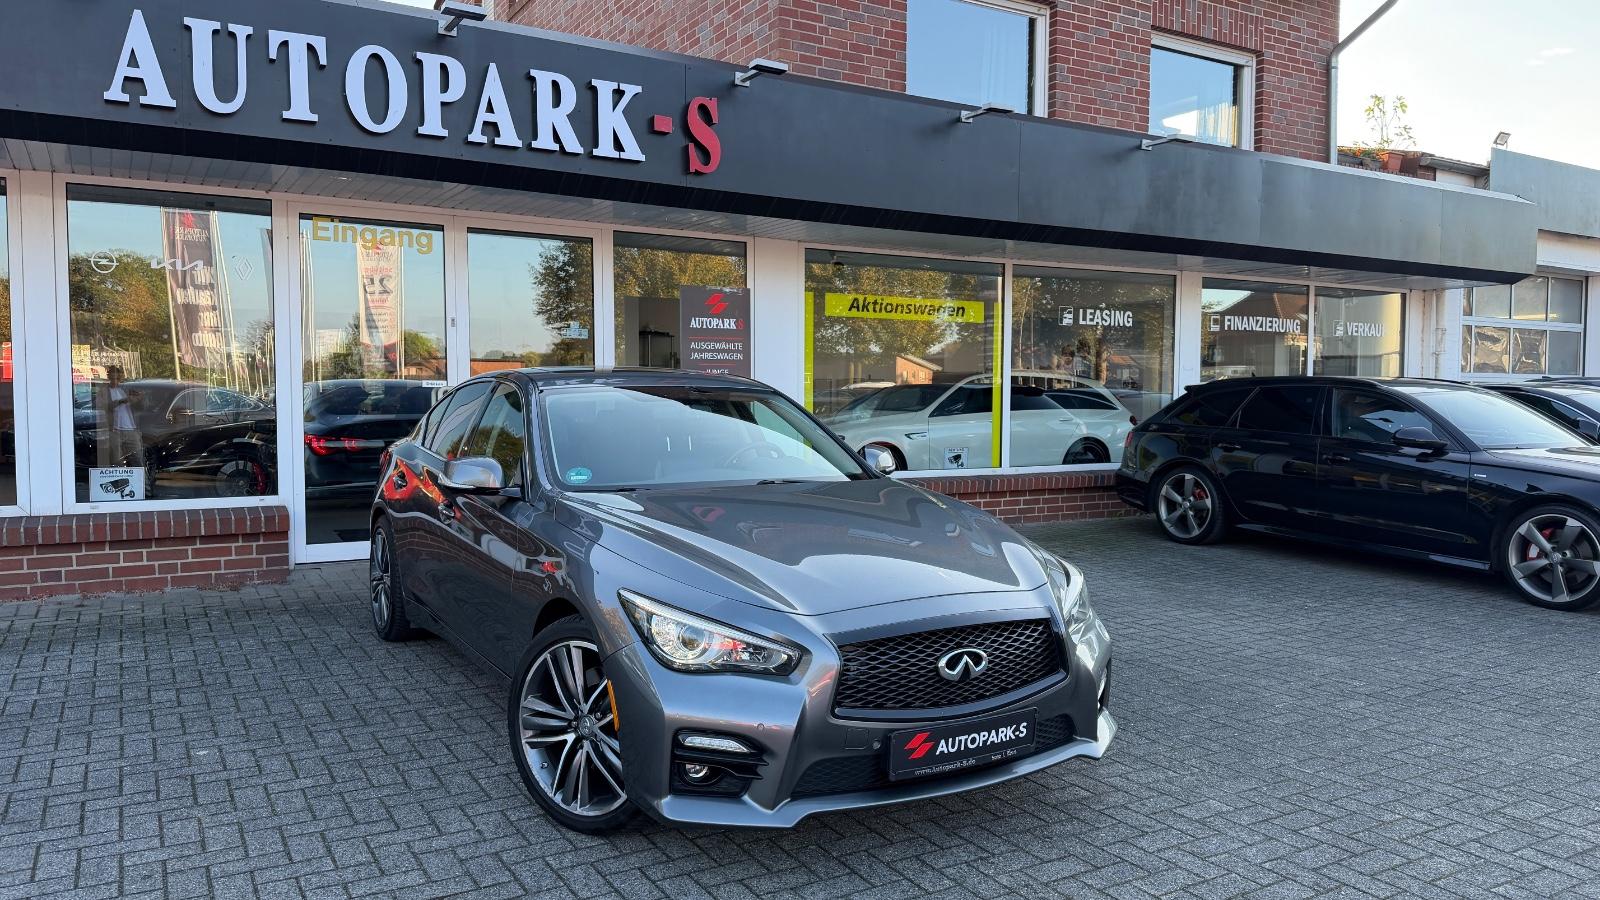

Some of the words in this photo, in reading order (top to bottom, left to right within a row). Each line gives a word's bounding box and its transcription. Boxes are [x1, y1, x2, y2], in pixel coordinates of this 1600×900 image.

[312, 216, 433, 254] Eingang
[848, 297, 967, 320] Aktionswagen
[1078, 308, 1133, 328] LEASING
[1224, 315, 1301, 335] FINANZIERUNG
[690, 341, 743, 351] AUSGEWÄHLTE
[690, 352, 744, 360] JAHRESWAGEN
[935, 722, 1028, 756] AUTOPARK-S
